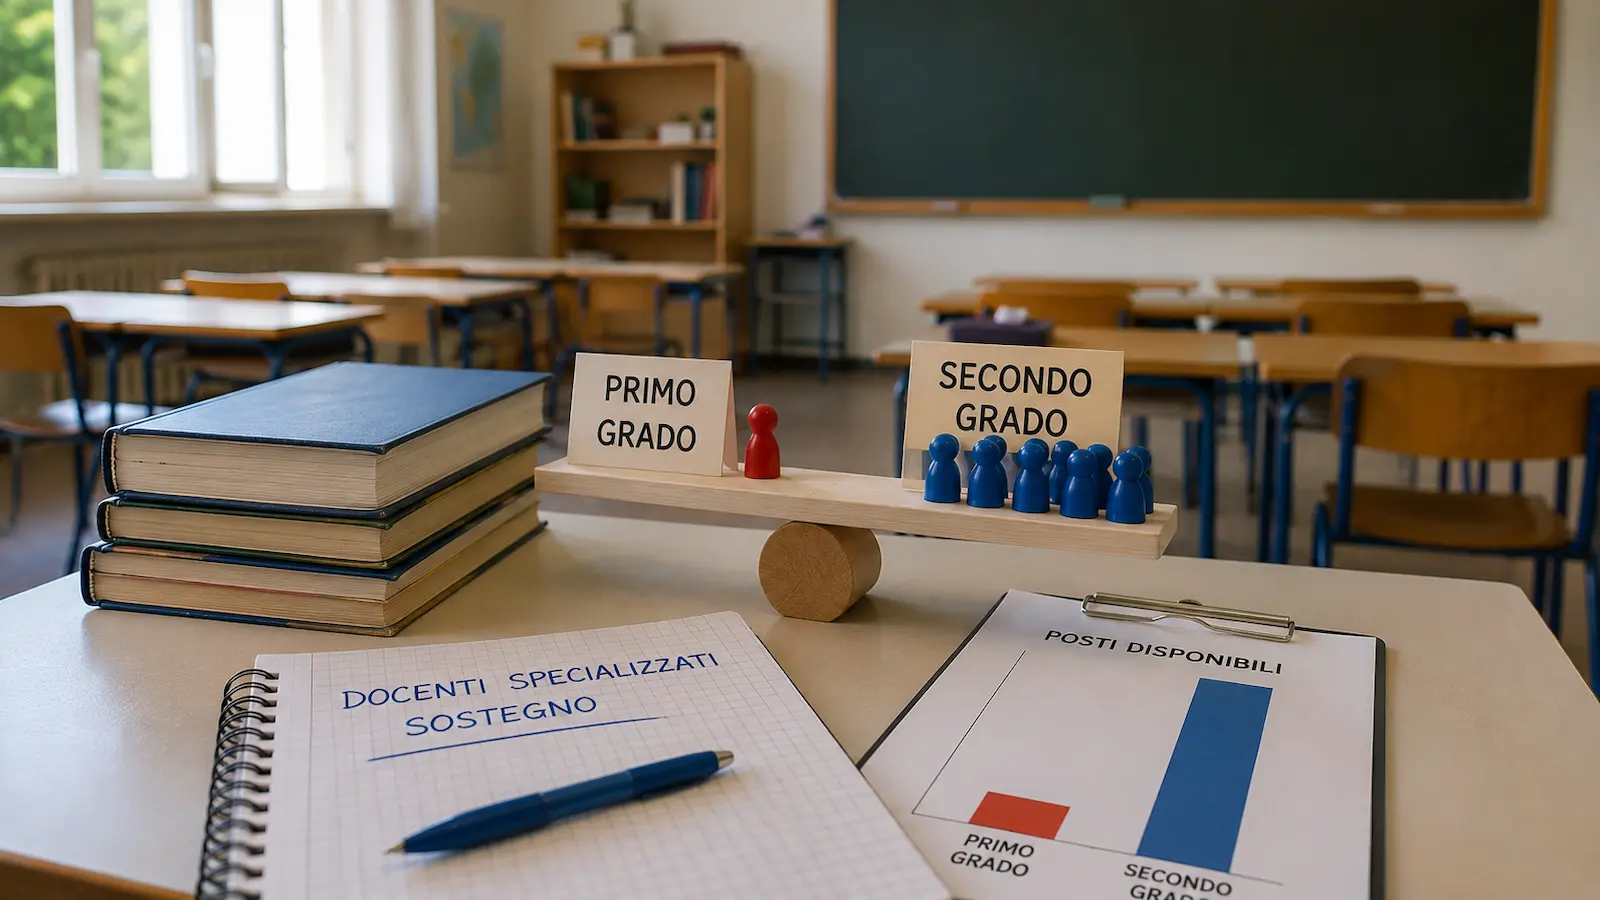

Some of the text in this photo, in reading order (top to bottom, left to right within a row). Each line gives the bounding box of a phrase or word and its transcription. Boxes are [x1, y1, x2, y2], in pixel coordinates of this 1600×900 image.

[604, 374, 697, 407] PRIMO
[938, 360, 1093, 398] SECONDO
[596, 418, 697, 453] GRADO
[955, 402, 1068, 438] GRADO
[1044, 629, 1282, 675] POSTI DISPONIBILI
[341, 652, 720, 710] DOCENTI SPECIALIZZATI
[405, 695, 598, 737] SOSTEGNO
[963, 833, 1035, 859] PRIMO
[950, 850, 1030, 878] GRADO
[1123, 863, 1233, 897] SECONDO
[1129, 884, 1210, 900] GRA
